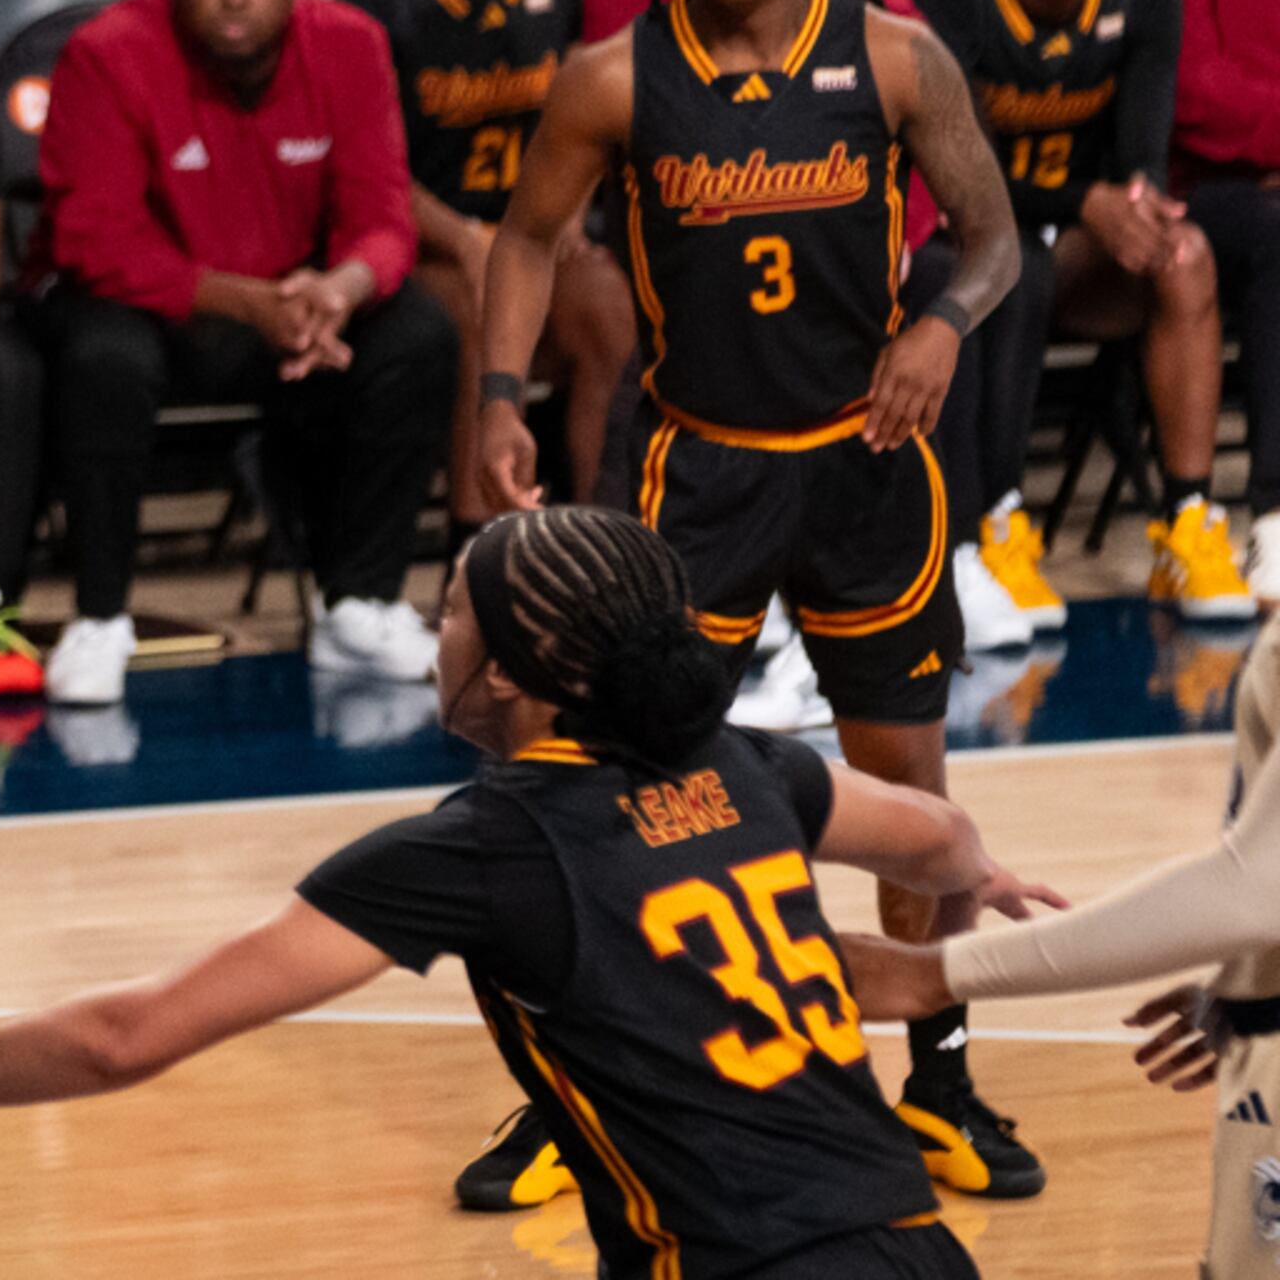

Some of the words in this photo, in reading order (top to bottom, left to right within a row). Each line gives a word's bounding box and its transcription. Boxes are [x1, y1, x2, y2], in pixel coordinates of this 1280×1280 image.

[653, 140, 870, 225] Warhawks
[743, 234, 797, 315] 3
[637, 846, 868, 1092] 35
